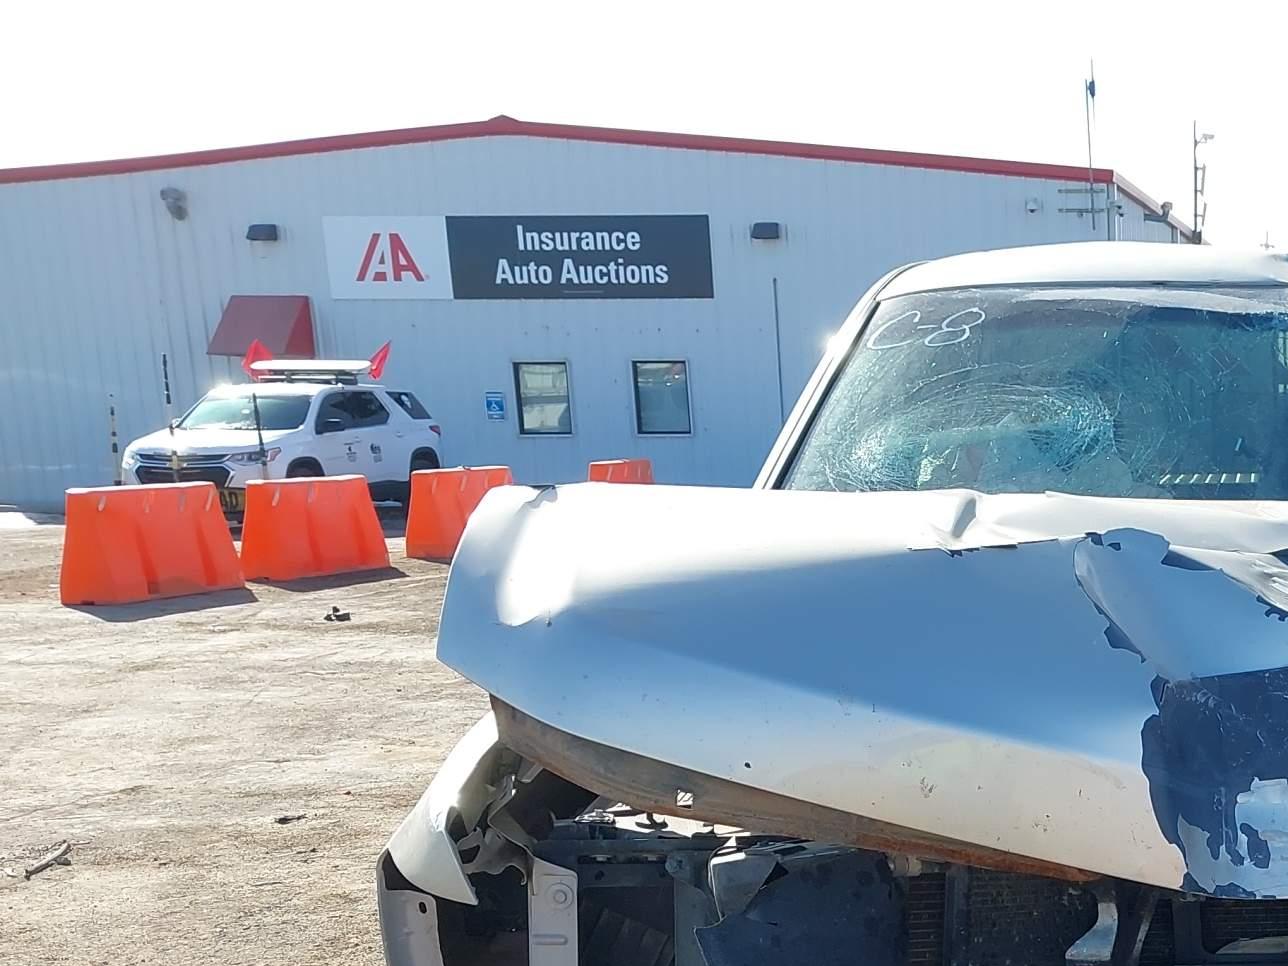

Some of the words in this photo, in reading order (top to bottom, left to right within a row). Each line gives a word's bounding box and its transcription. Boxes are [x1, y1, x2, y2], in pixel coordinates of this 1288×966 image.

[516, 224, 641, 251] Insurance
[495, 258, 553, 285] Auto
[559, 258, 669, 285] Auctions
